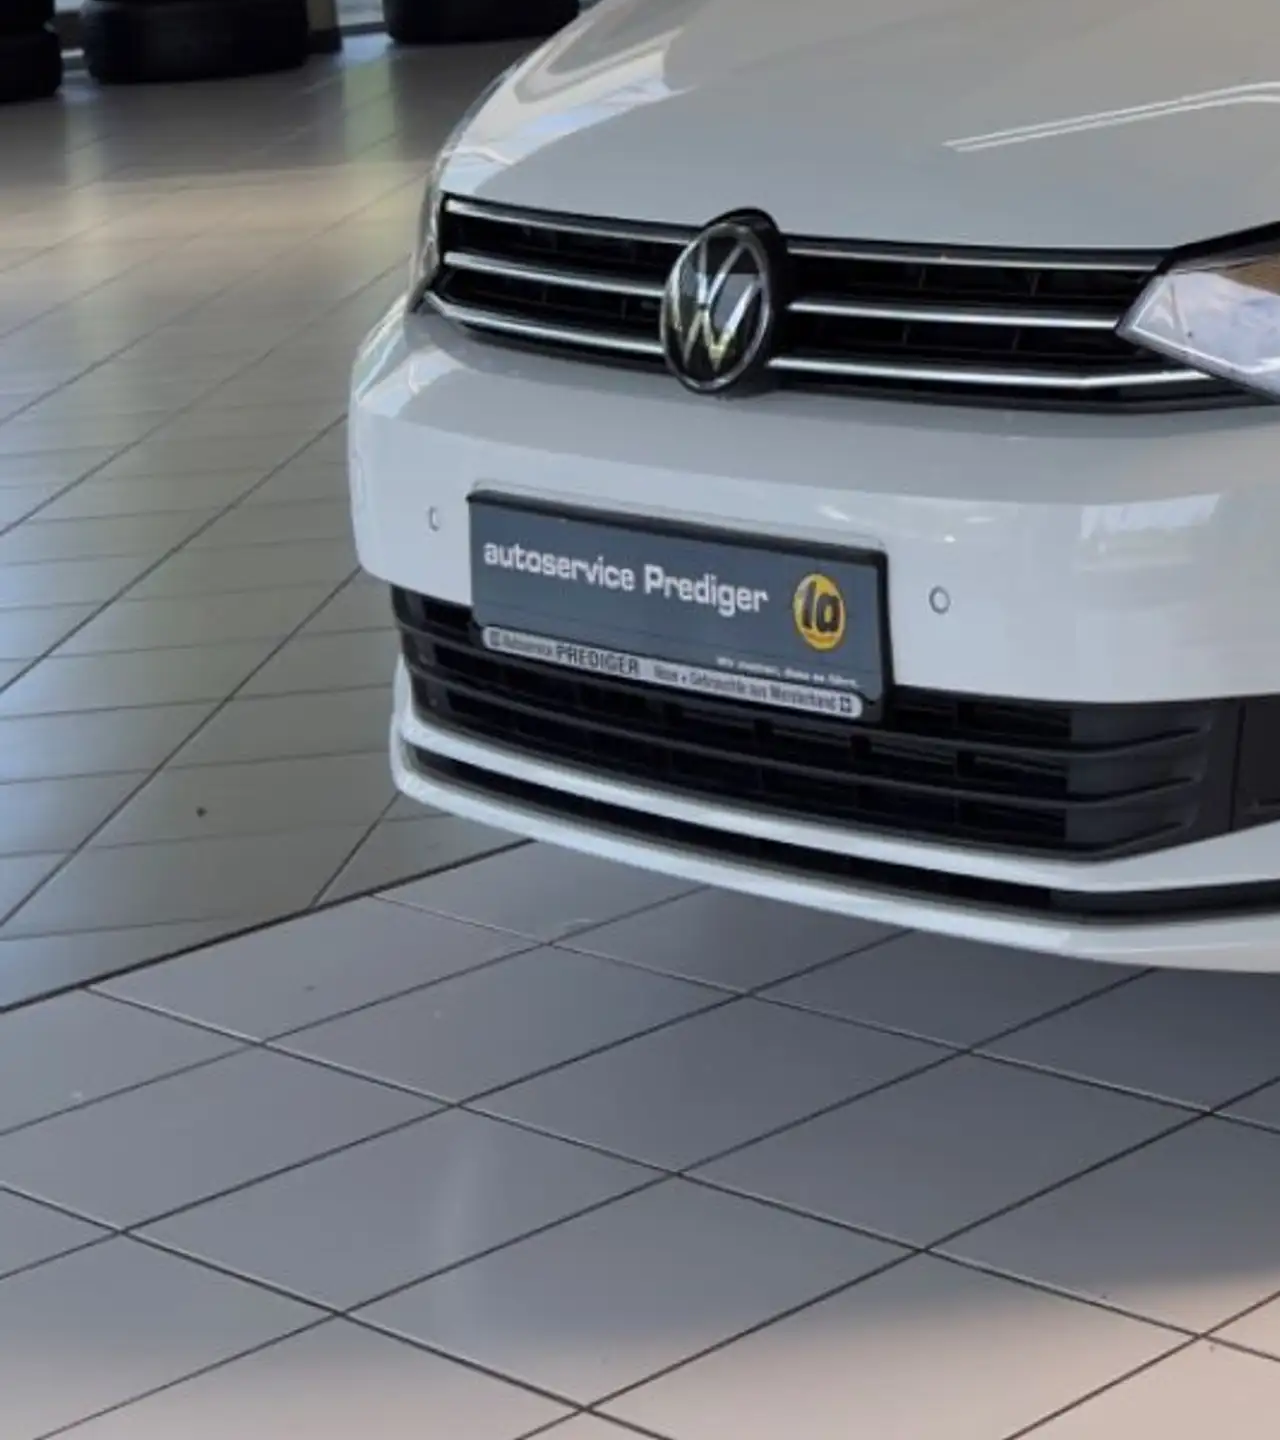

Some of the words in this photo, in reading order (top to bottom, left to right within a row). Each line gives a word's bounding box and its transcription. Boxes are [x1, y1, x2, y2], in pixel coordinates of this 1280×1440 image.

[483, 541, 635, 593] autoservice
[643, 563, 770, 618] Prediger
[555, 644, 640, 676] PREDIGER
